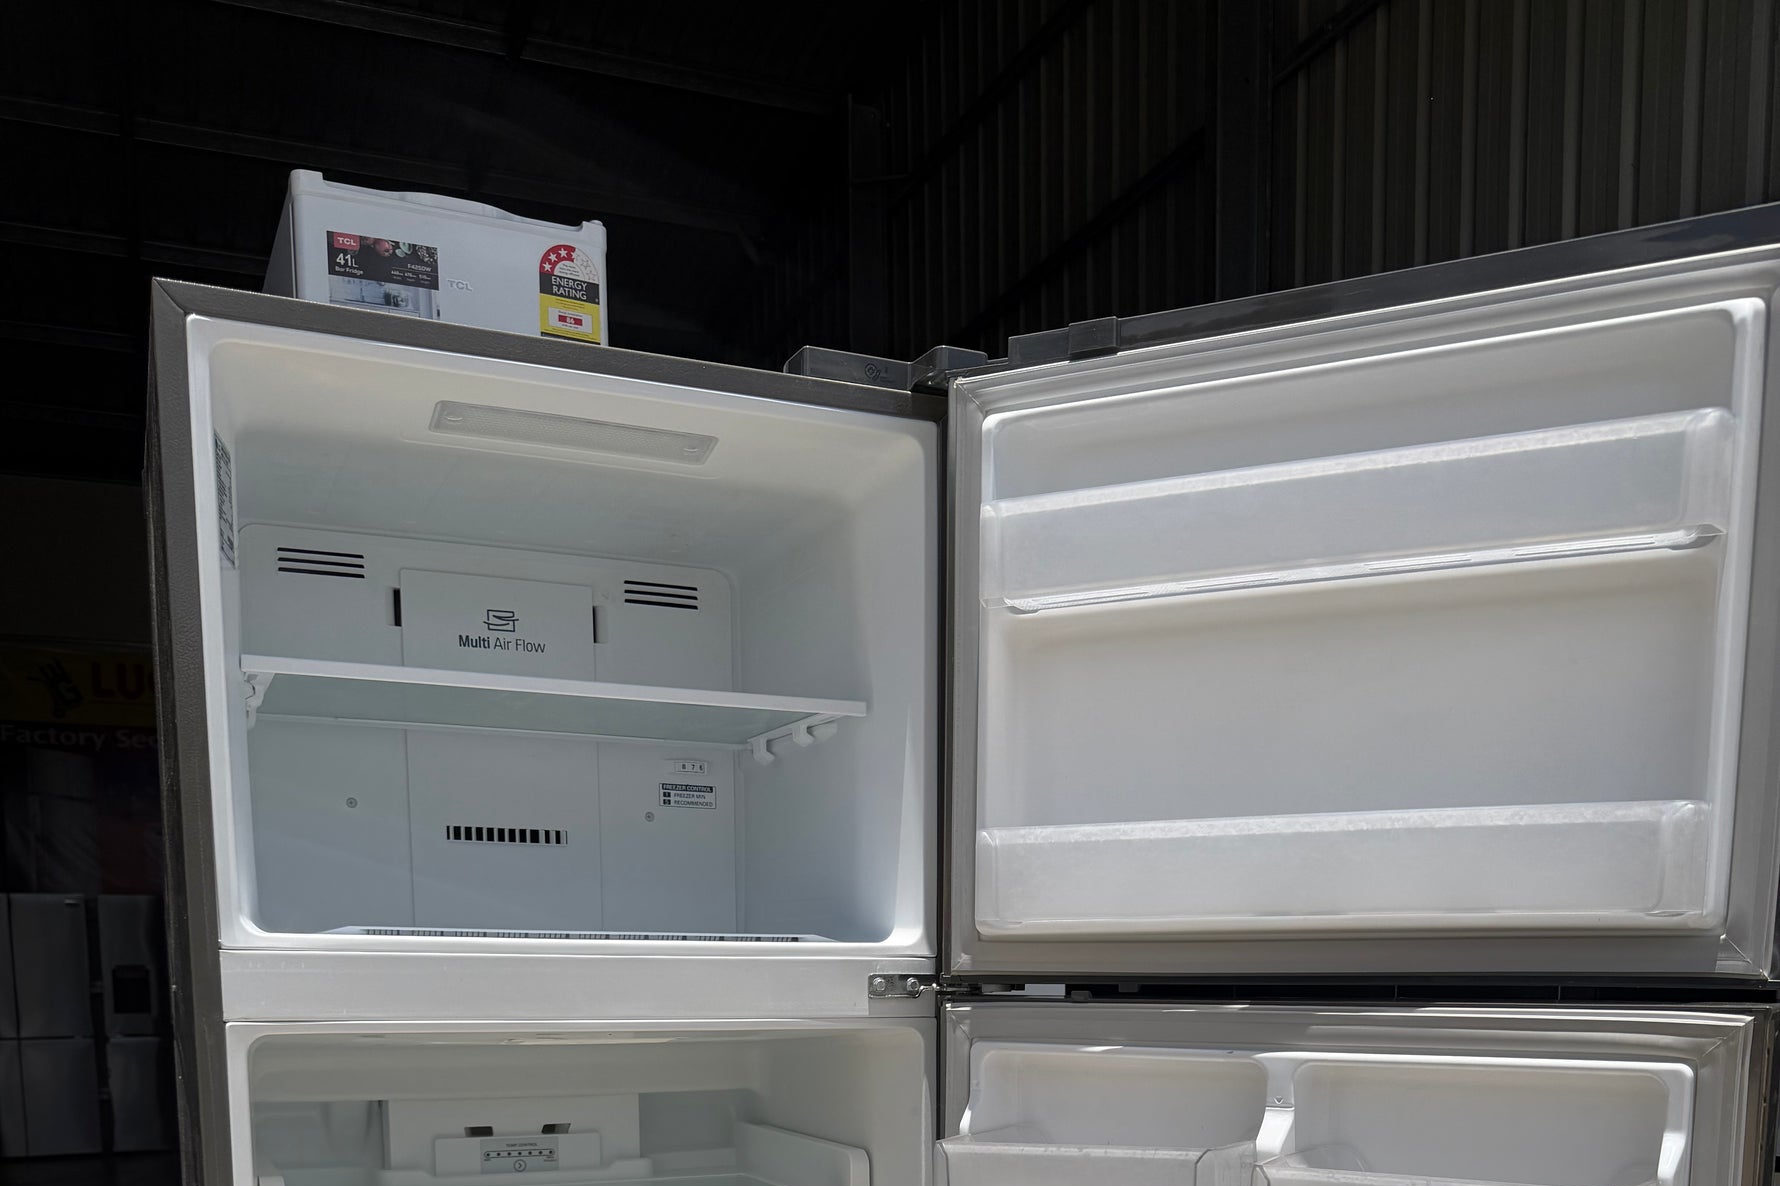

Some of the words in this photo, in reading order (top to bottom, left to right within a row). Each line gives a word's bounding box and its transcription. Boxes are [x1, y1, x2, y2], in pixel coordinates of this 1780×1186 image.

[337, 237, 357, 246] TCL
[335, 265, 346, 273] Bar
[346, 266, 364, 276] Fridge
[447, 279, 473, 292] TCL
[551, 276, 588, 291] ENERGY
[552, 285, 587, 300] RATING
[458, 634, 490, 649] Multi
[493, 637, 512, 651] Air
[515, 639, 546, 653] Flow
[0, 723, 105, 752] Factory
